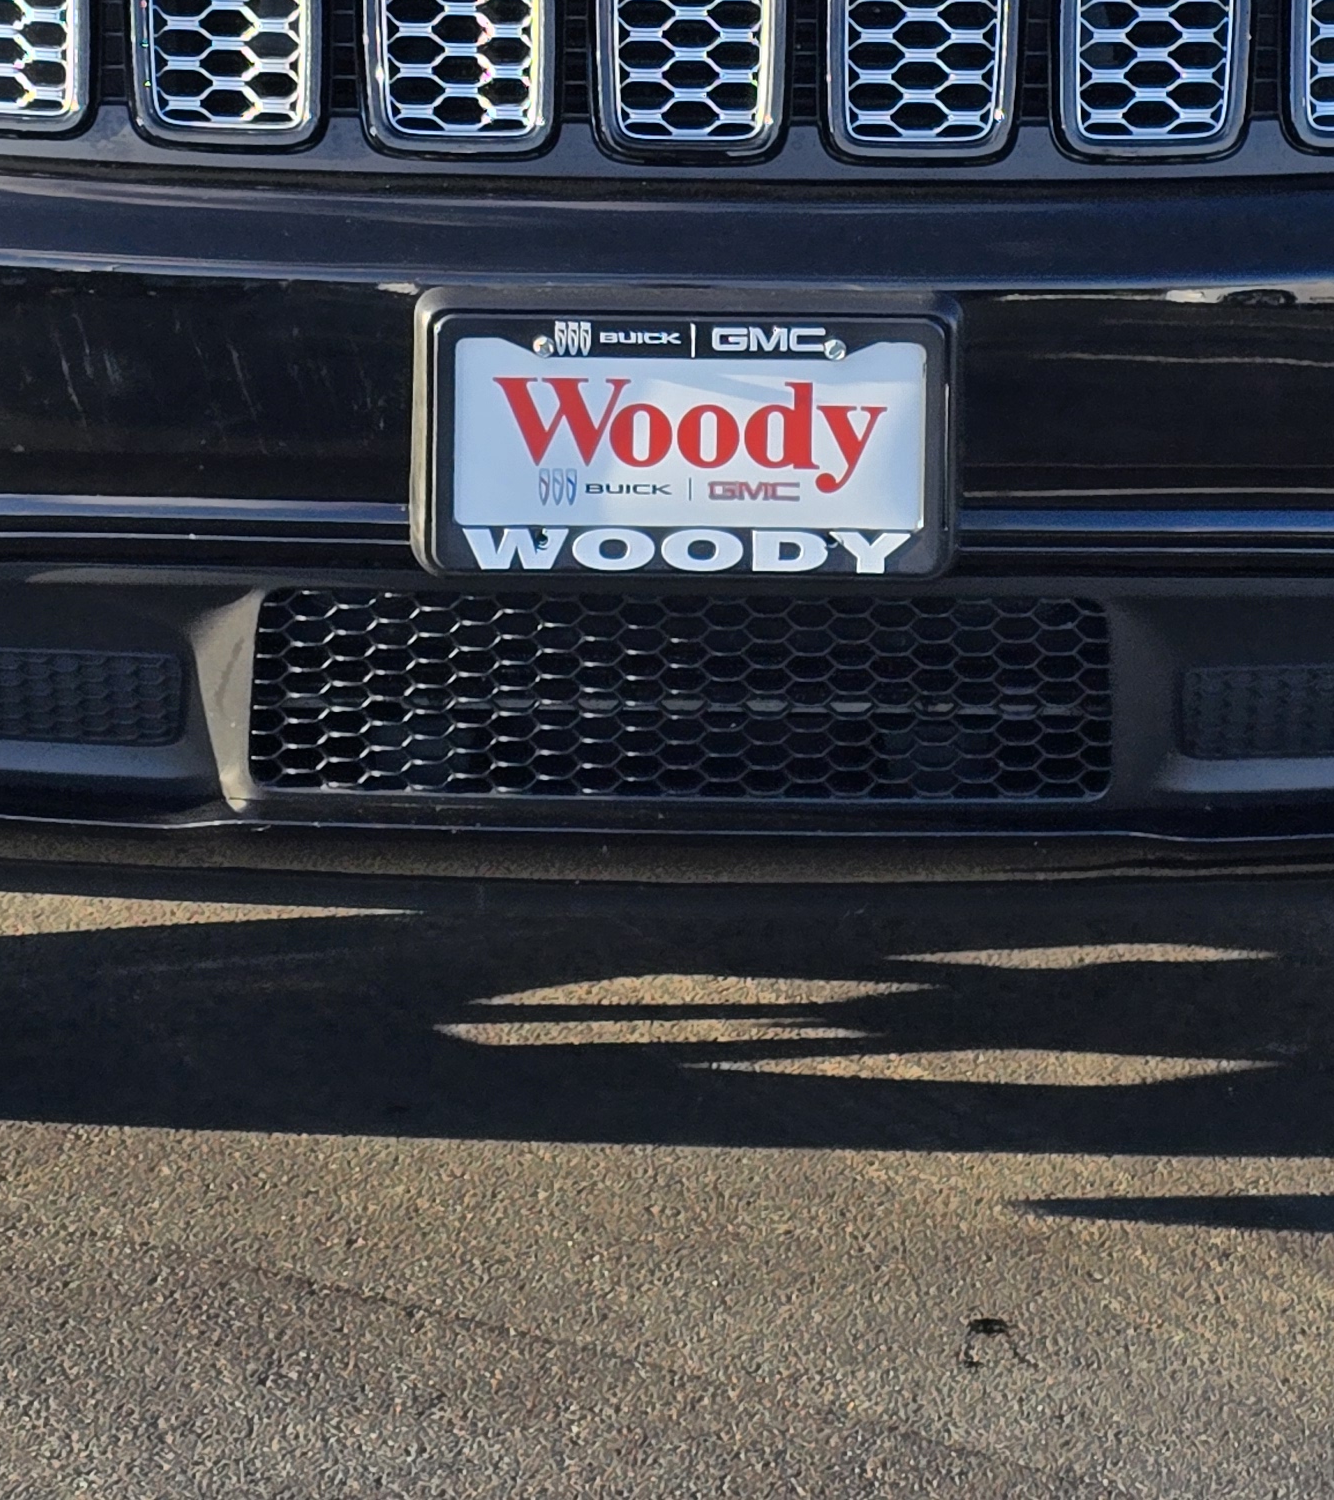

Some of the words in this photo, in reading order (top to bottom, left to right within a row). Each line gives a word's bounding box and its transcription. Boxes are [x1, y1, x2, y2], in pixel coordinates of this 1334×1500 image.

[599, 331, 681, 345] BUICK
[711, 326, 826, 352] GMC
[492, 377, 888, 494] Woody
[584, 483, 673, 496] BUICK
[707, 481, 801, 502] GMC
[463, 527, 911, 575] WOODY
